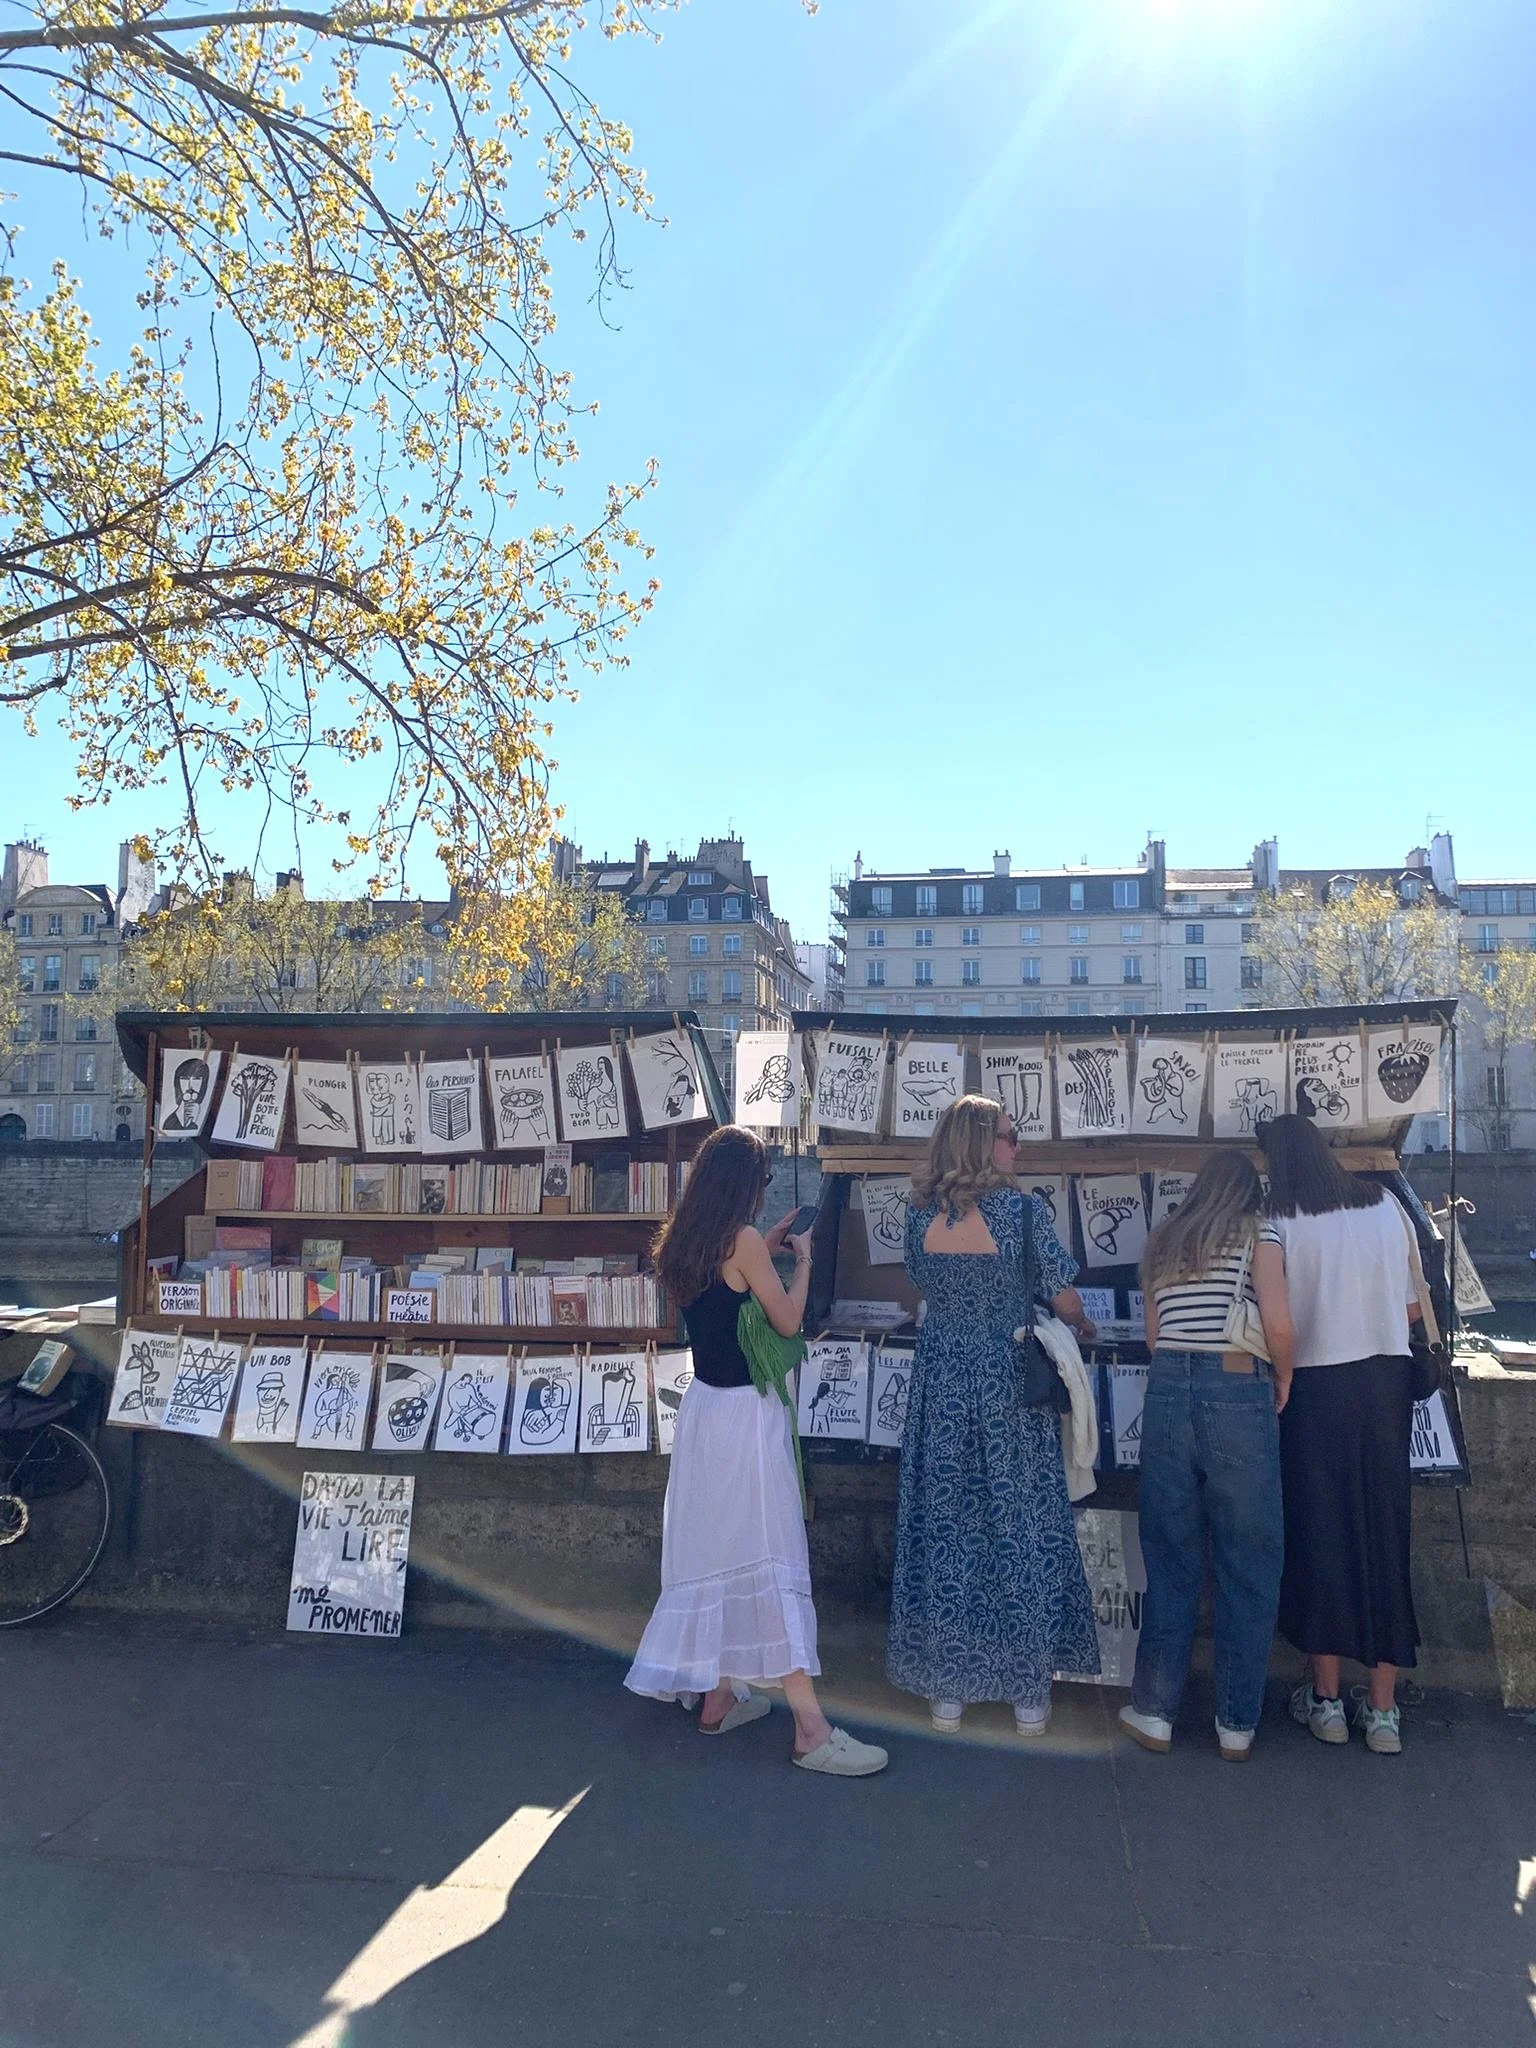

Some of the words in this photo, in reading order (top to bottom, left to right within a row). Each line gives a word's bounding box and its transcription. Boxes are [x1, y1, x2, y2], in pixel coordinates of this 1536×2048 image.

[828, 1041, 881, 1061] FUTSAL!
[908, 1060, 949, 1075] BELLE
[985, 1055, 1019, 1070] SHINY
[1169, 1050, 1201, 1082] SAXO!
[1294, 1056, 1318, 1066] PLUS
[494, 1066, 544, 1082] FALAFEL
[1294, 1063, 1334, 1076] PENSER
[308, 1077, 347, 1090] PLONGER
[1065, 1082, 1085, 1096] DES
[253, 1113, 266, 1124] DE
[1083, 1188, 1098, 1201] LE
[1085, 1196, 1141, 1212] CROISSANT
[250, 1355, 267, 1367] UN
[269, 1354, 291, 1366] BOB
[590, 1359, 635, 1373] RADIEUSE
[878, 1356, 894, 1367] LES
[144, 1385, 156, 1396] DE
[377, 1476, 407, 1502] LA
[302, 1501, 334, 1530] VIE
